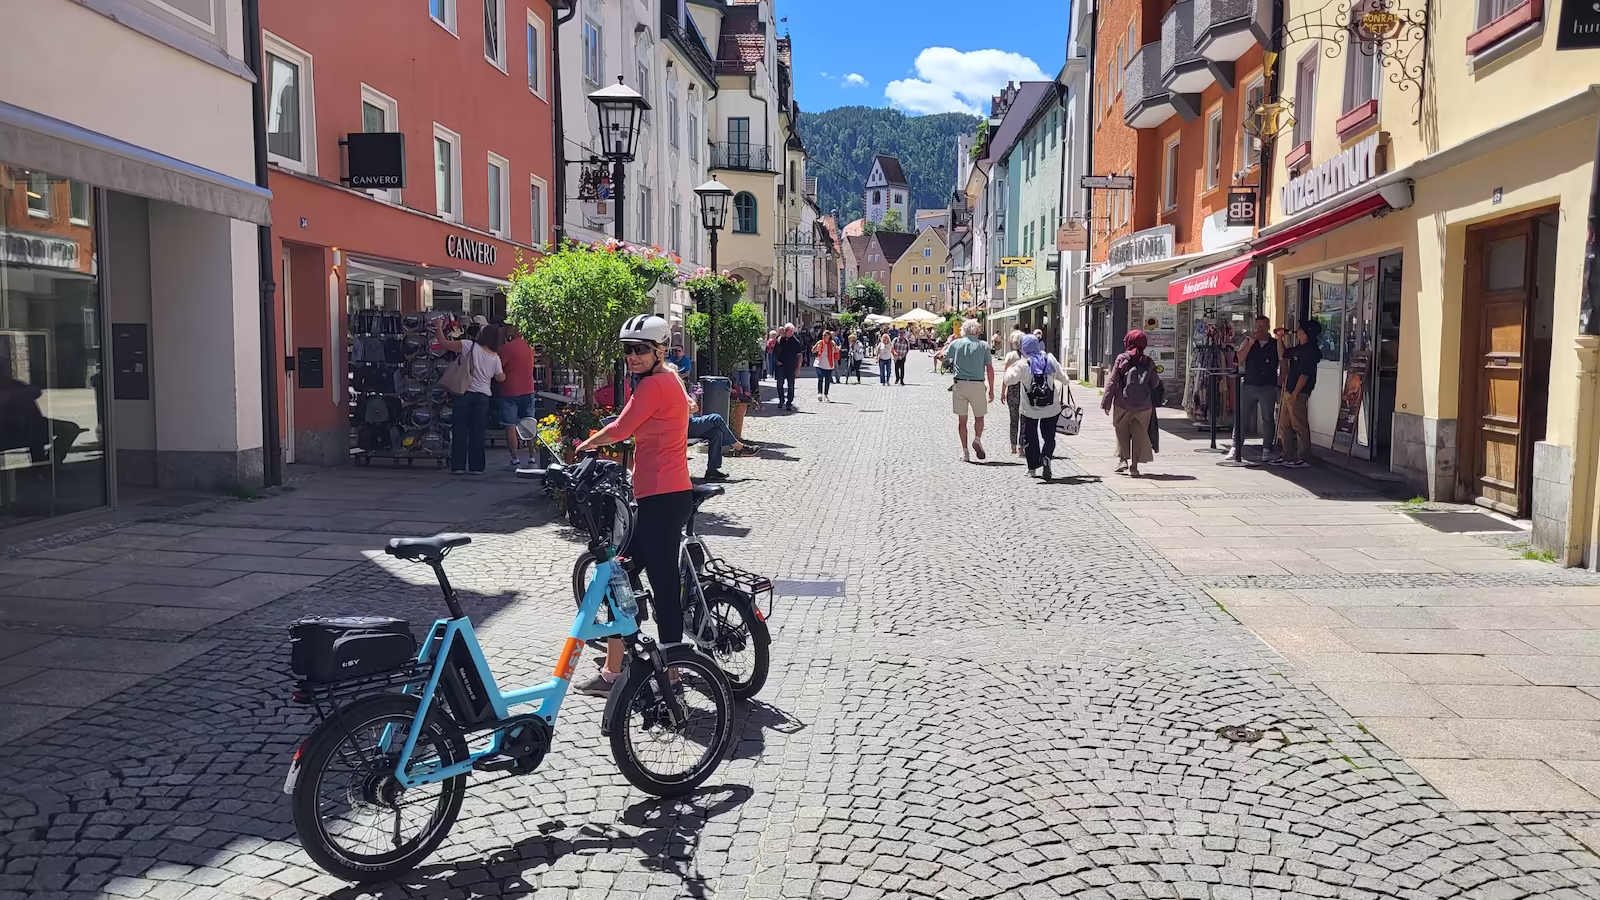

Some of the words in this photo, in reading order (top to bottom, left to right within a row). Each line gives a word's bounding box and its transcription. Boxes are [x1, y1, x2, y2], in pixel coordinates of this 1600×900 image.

[1363, 13, 1398, 22] KONRAD
[352, 175, 399, 184] CANVERO
[1280, 131, 1379, 216] vinzenzmurr
[447, 234, 497, 266] CANVERO
